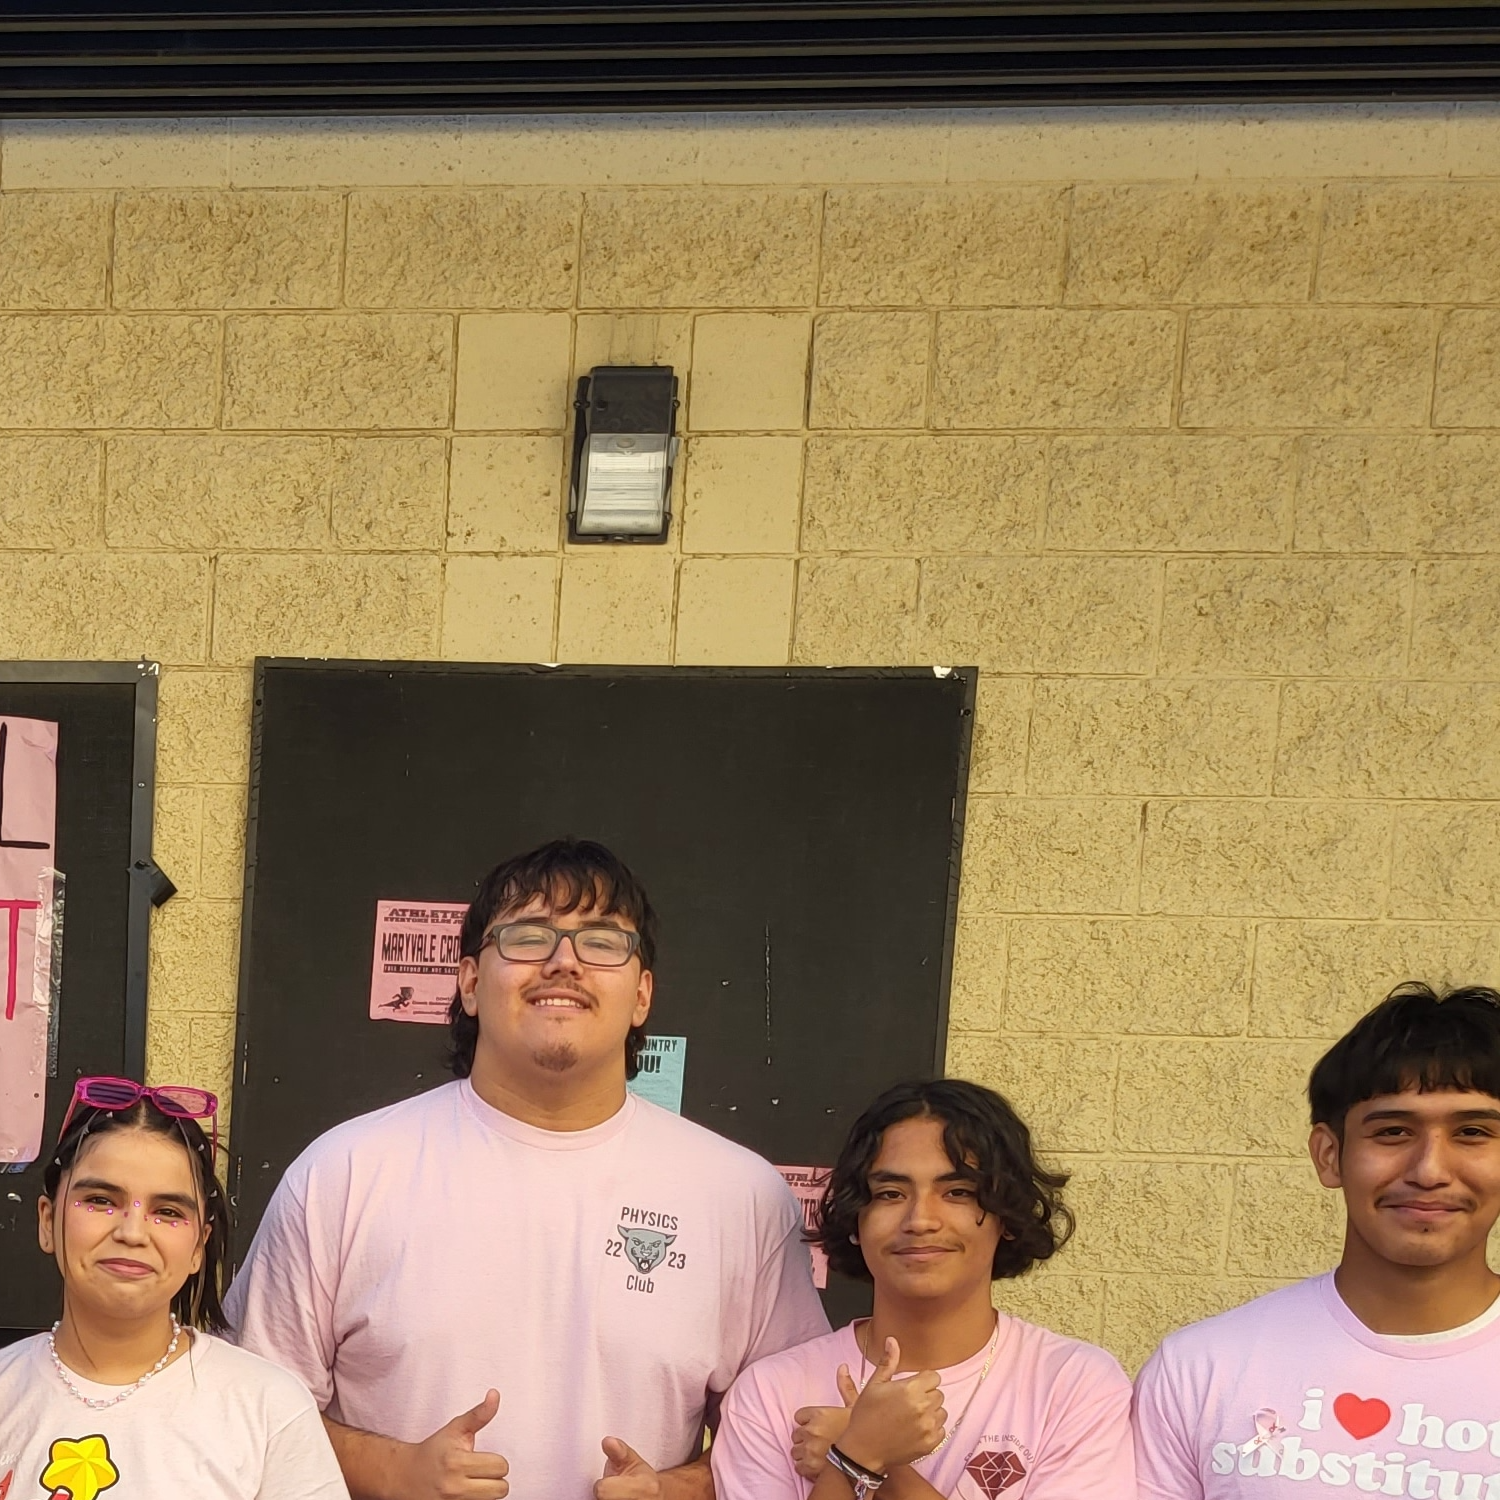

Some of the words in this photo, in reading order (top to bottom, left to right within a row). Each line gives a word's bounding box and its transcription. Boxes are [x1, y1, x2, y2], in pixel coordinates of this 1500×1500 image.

[381, 932, 437, 962] MARYVALE
[440, 934, 461, 964] CRO
[644, 1038, 678, 1053] UNTRY
[636, 1054, 662, 1074] OU!
[620, 1206, 679, 1231] PHYSICS
[605, 1238, 623, 1258] 22
[667, 1251, 687, 1270] 23
[626, 1274, 655, 1294] Club
[1298, 1387, 1325, 1431] i
[982, 1435, 1000, 1443] THE
[1001, 1434, 1024, 1451] INSIDE
